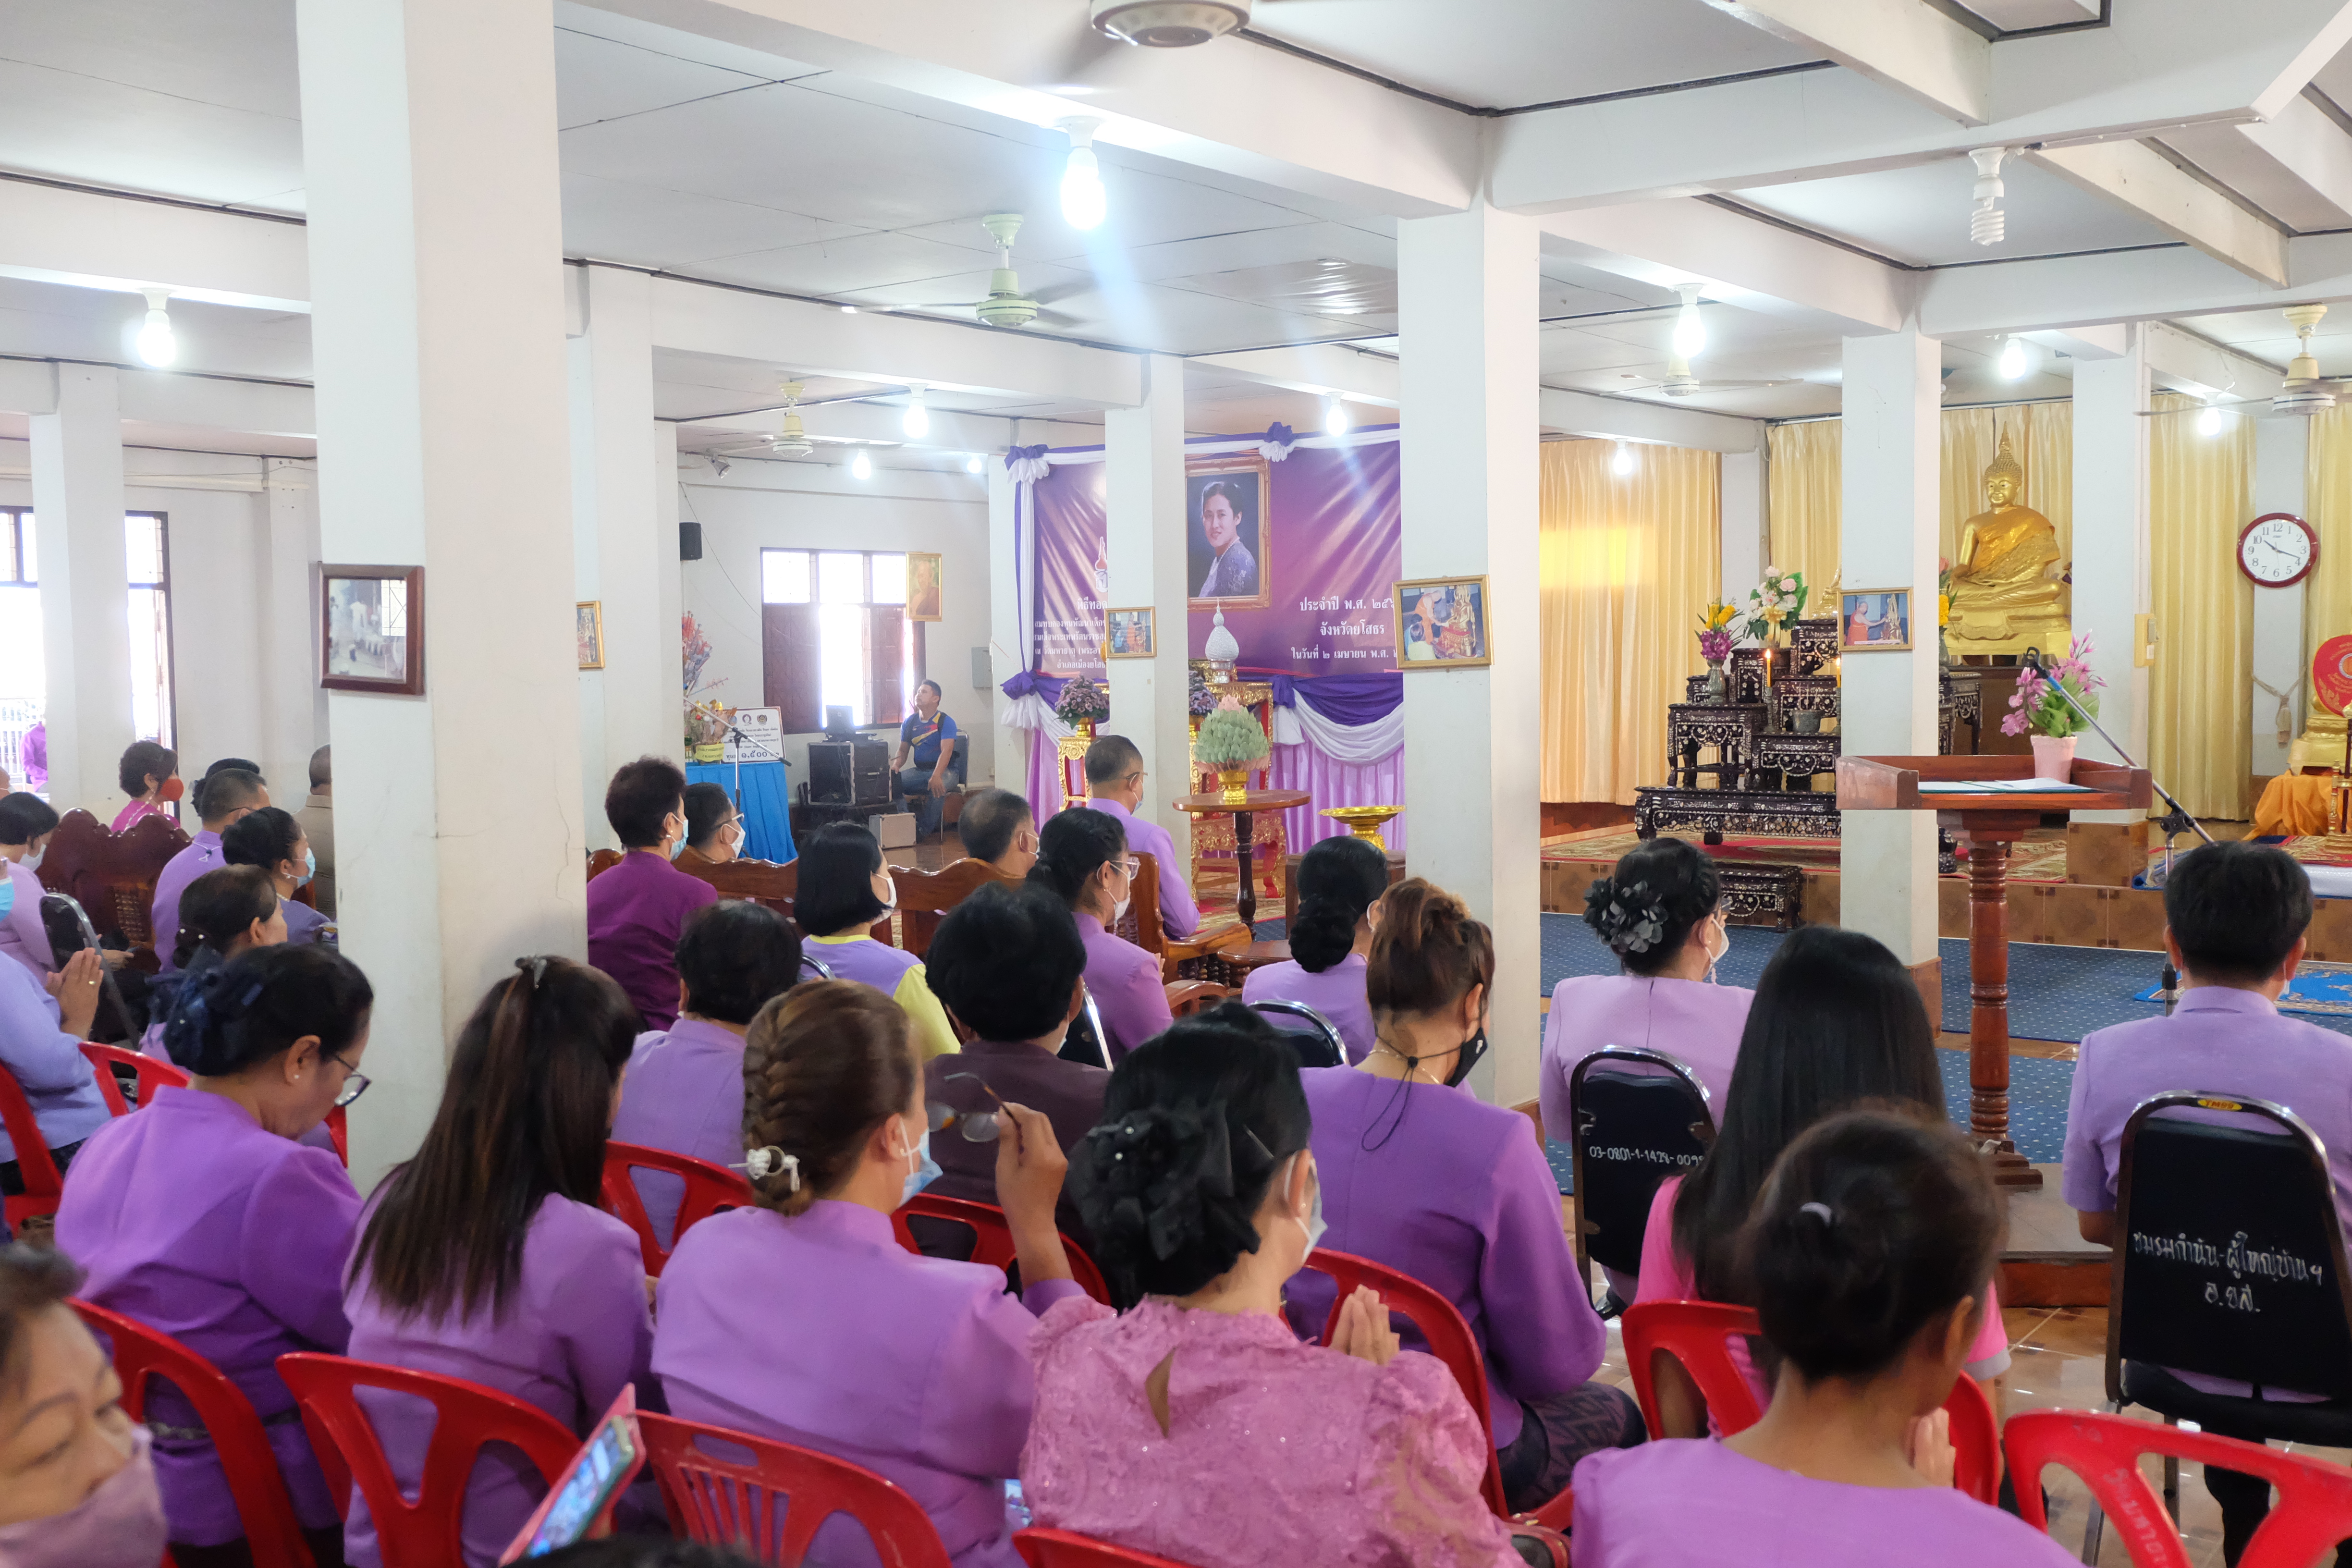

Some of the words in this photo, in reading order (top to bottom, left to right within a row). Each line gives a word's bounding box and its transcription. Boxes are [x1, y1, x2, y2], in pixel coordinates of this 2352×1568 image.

[2262, 527, 2269, 535] 11
[2273, 523, 2283, 532] 12
[2288, 526, 2291, 534] 1
[2253, 536, 2262, 544] 10
[2296, 534, 2302, 542] 2
[2248, 546, 2254, 554] 9
[2300, 546, 2306, 554] 3
[2252, 558, 2259, 566] 8
[2295, 557, 2302, 565] 4
[2262, 566, 2267, 574] 7
[2273, 569, 2279, 577] 6
[2286, 566, 2292, 574] 5
[1300, 596, 1339, 611] ประจำปี
[1345, 600, 1366, 609] พ.ศ.
[1320, 619, 1384, 635] จังหวัดยโสธร
[1291, 644, 1319, 659] ในวันที่
[1323, 650, 1330, 659] ๒
[1334, 650, 1366, 659] เมษายน
[1371, 650, 1389, 658] พ.ศ.
[741, 750, 767, 758] ๑,๕๐๐
